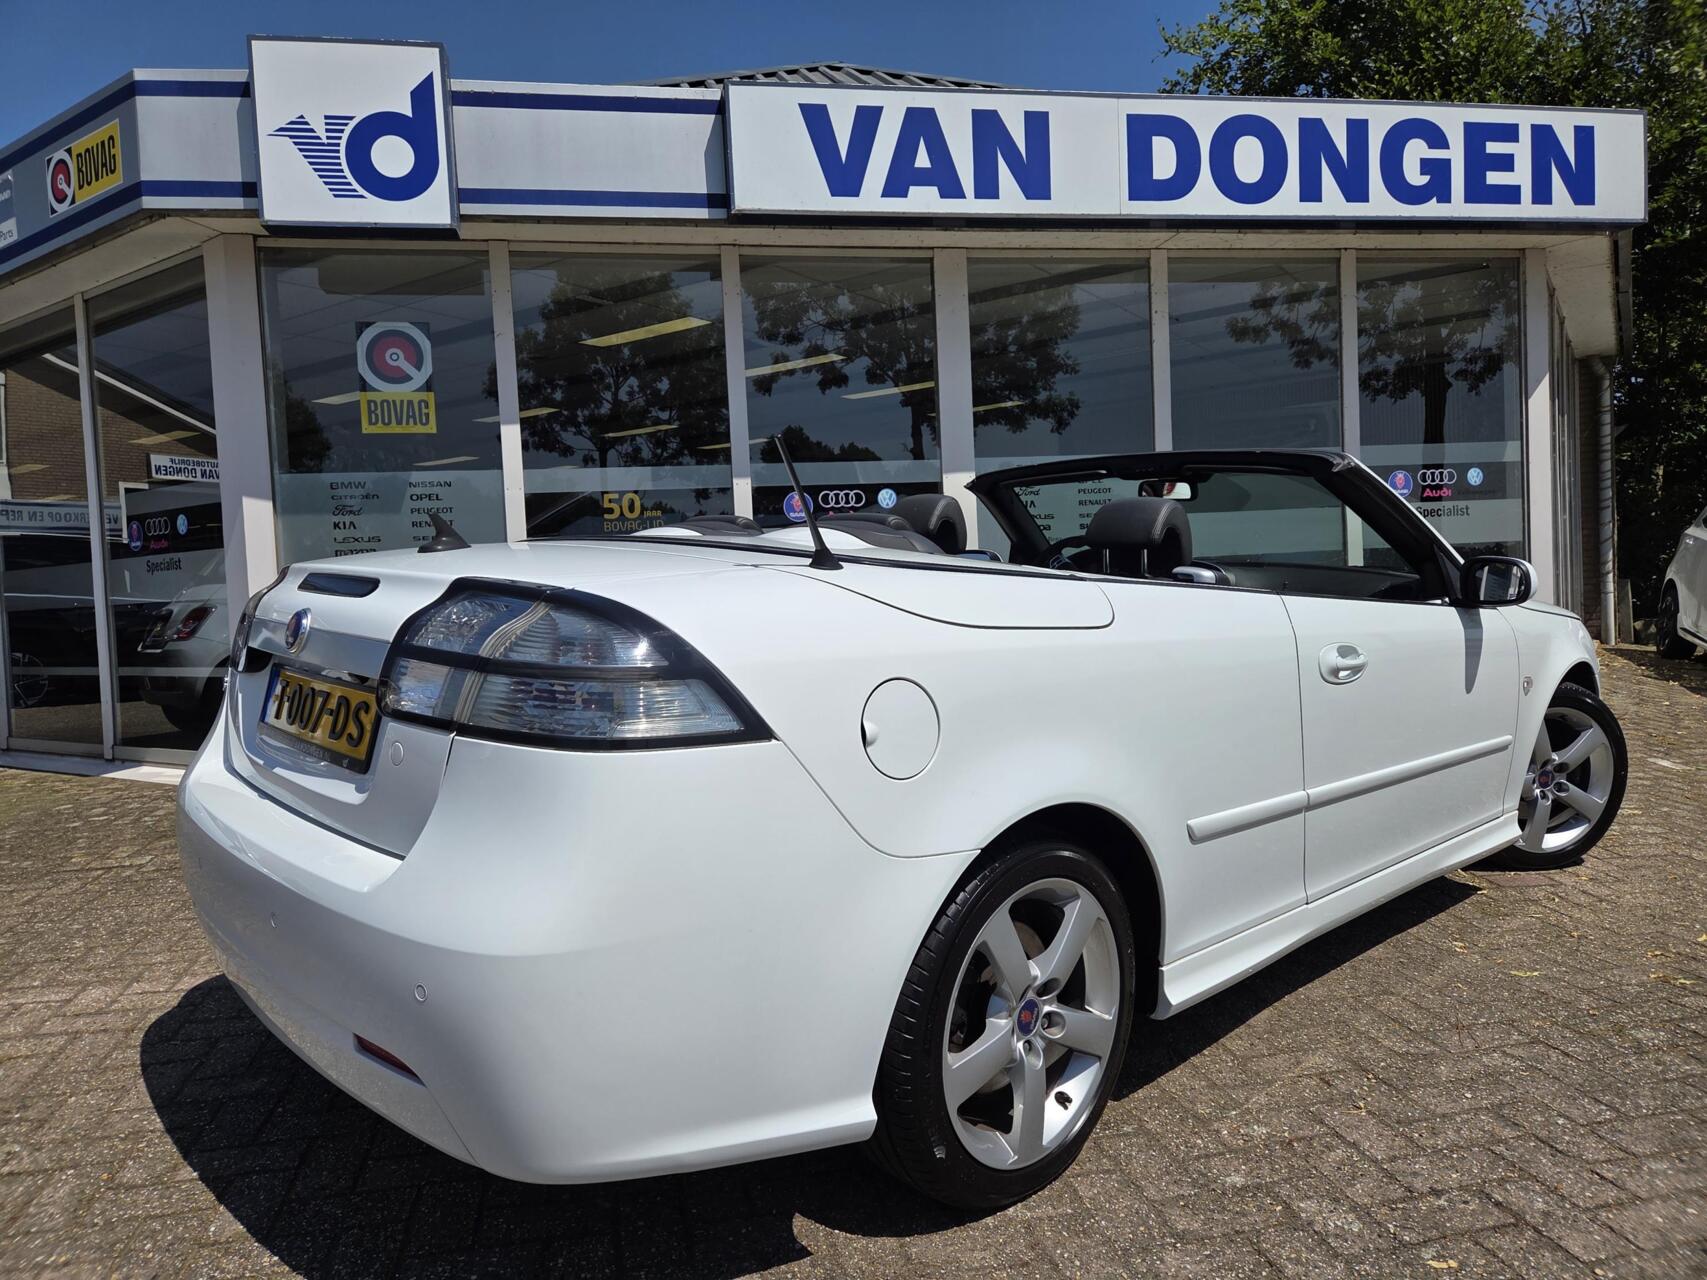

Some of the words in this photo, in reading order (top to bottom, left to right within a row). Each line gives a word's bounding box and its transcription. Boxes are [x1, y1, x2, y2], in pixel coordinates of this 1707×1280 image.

[798, 103, 1051, 200] VAN
[1127, 113, 1597, 206] DONGEN
[76, 133, 117, 191] BOVAG
[368, 399, 430, 426] BOVAG
[330, 482, 366, 490] BMW
[410, 493, 443, 501] OPEL
[1423, 488, 1452, 497] Audi
[332, 504, 362, 516] Ford
[411, 506, 454, 515] PEUGEOT
[603, 492, 641, 520] 50
[1416, 504, 1470, 518] Specialist
[333, 521, 357, 530] KIA
[412, 520, 455, 528] RENT
[146, 557, 182, 575] Specialist
